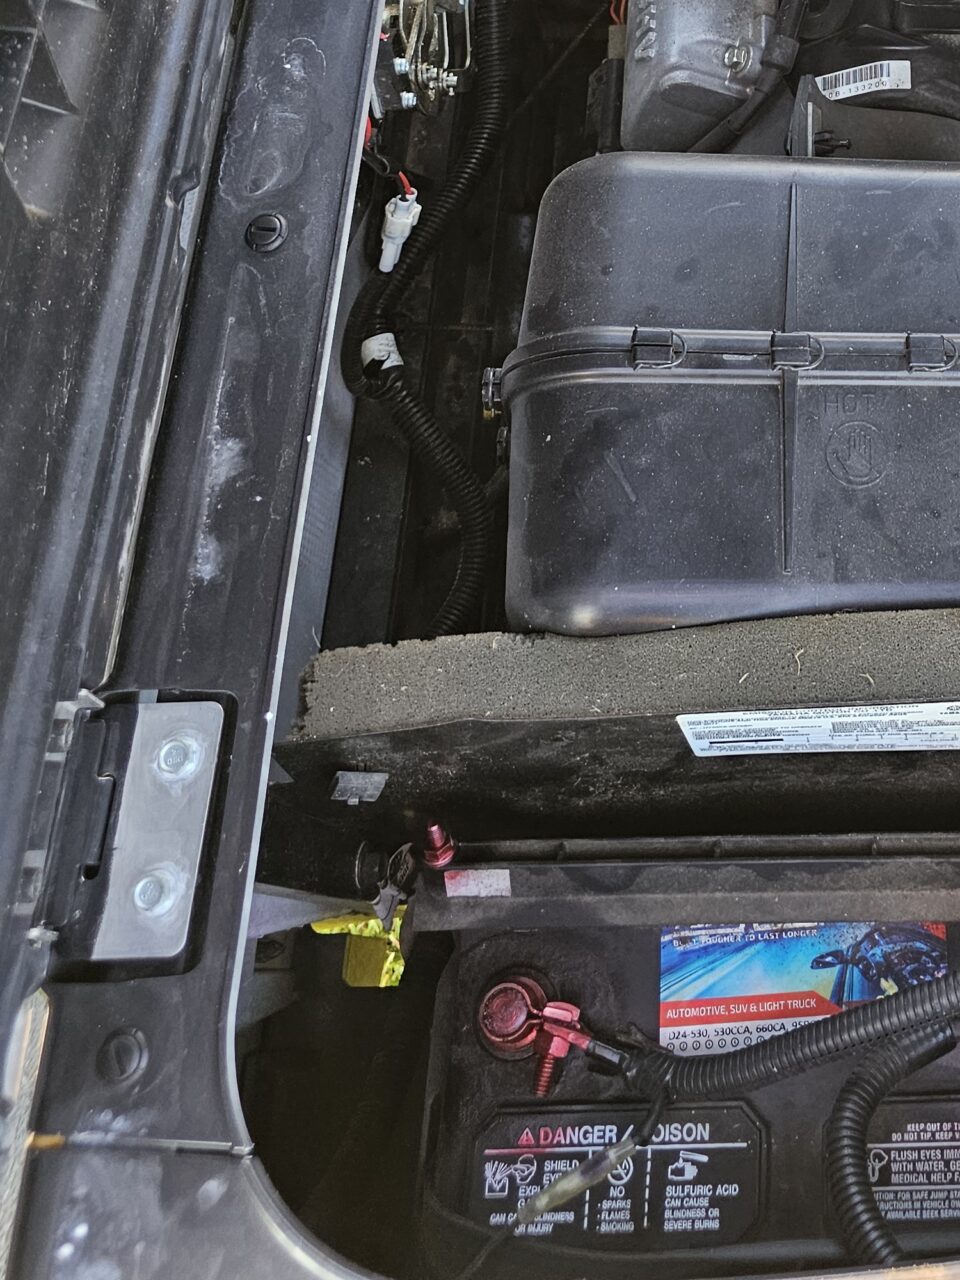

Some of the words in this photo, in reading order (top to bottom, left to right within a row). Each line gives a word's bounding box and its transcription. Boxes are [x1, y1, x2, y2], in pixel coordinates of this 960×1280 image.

[824, 393, 875, 415] HOT
[745, 934, 755, 942] TO
[758, 932, 779, 941] LAST
[782, 929, 818, 939] LONGER
[666, 1003, 729, 1020] AUTOMOTIVE,
[730, 1001, 748, 1015] SUV
[750, 1001, 757, 1013] &
[759, 999, 786, 1013] LIGHT
[787, 997, 817, 1010] TRUCK
[668, 1028, 710, 1041] D24-530,
[714, 1025, 753, 1037] 530CCA,
[755, 1022, 789, 1035] 660CA,
[907, 1122, 925, 1132] KEEP
[926, 1122, 941, 1132] OUT
[942, 1122, 952, 1131] OF
[540, 1125, 618, 1145] DANGER
[652, 1123, 710, 1142] OISON
[892, 1132, 902, 1141] DO
[903, 1132, 918, 1141] NOT
[935, 1131, 953, 1140] KEEP
[891, 1149, 918, 1161] FLUSH
[920, 1148, 941, 1160] EYES
[544, 1160, 579, 1171] SHIELD
[891, 1161, 913, 1171] WITH
[891, 1172, 928, 1183] MEDICAL
[930, 1172, 953, 1183] HELP
[610, 1186, 625, 1197] NO
[665, 1186, 712, 1196] SULFURIC
[716, 1184, 739, 1195] ACID
[897, 1191, 911, 1200] FOR
[912, 1191, 928, 1199] SAFE
[930, 1190, 948, 1199] JUMP
[602, 1200, 631, 1209] SPARKS
[665, 1198, 682, 1207] CAN
[684, 1197, 709, 1207] CAUSE
[914, 1200, 921, 1209] IN
[922, 1200, 949, 1209] VEHICLE
[490, 1212, 506, 1223] CAN
[601, 1210, 631, 1220] FLAMES
[664, 1209, 705, 1219] BLINDNESS
[708, 1208, 720, 1218] OR
[887, 1210, 920, 1219] AVAILABLE
[922, 1209, 939, 1218] SEEK
[527, 1222, 554, 1233] INJURY
[600, 1221, 635, 1232] SMOKING
[664, 1220, 692, 1230] SEVERE
[695, 1218, 720, 1229] BURNS
